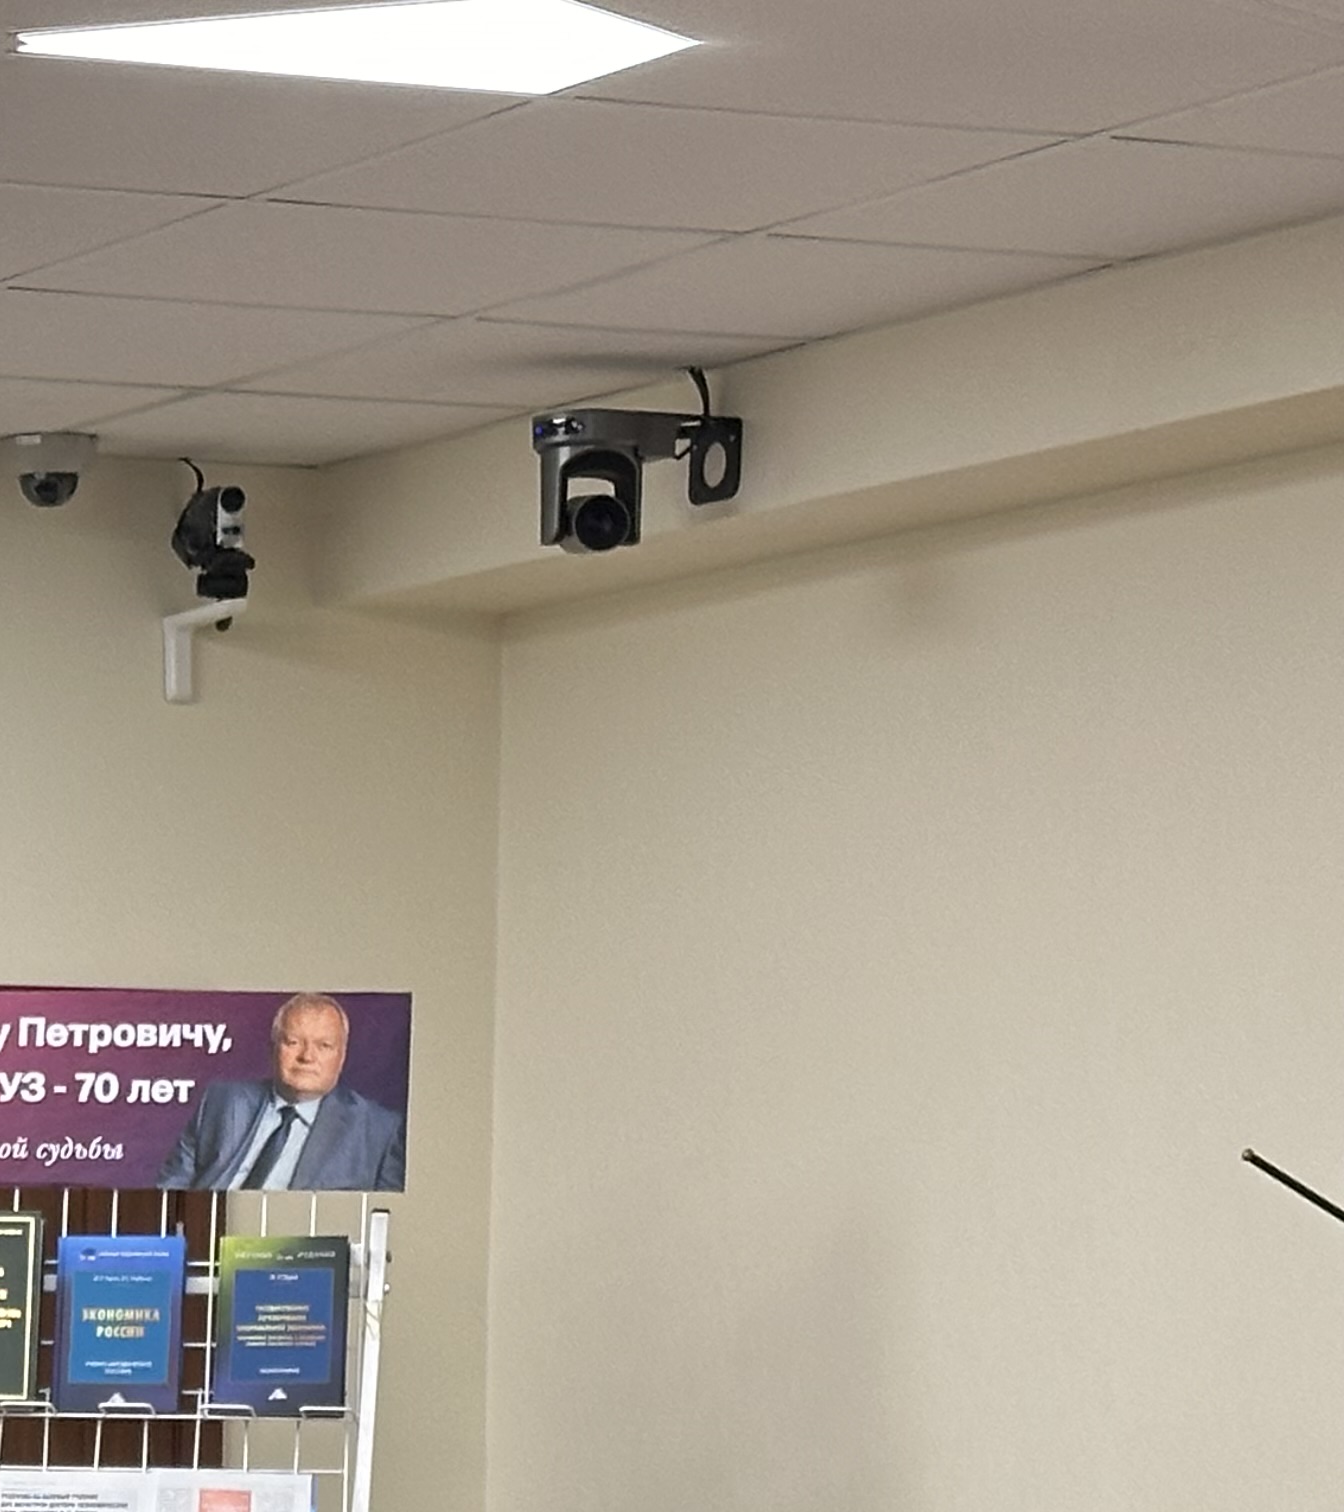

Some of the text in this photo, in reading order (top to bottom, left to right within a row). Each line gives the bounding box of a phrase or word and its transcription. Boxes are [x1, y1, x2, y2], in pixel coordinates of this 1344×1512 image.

[18, 1016, 233, 1054] Петровичу,
[74, 1071, 119, 1103] 70
[126, 1078, 195, 1103] лет
[36, 1136, 124, 1167] судьбы
[82, 1308, 160, 1321] ЭКОНОМИКА
[96, 1326, 145, 1338] РОССИИ
